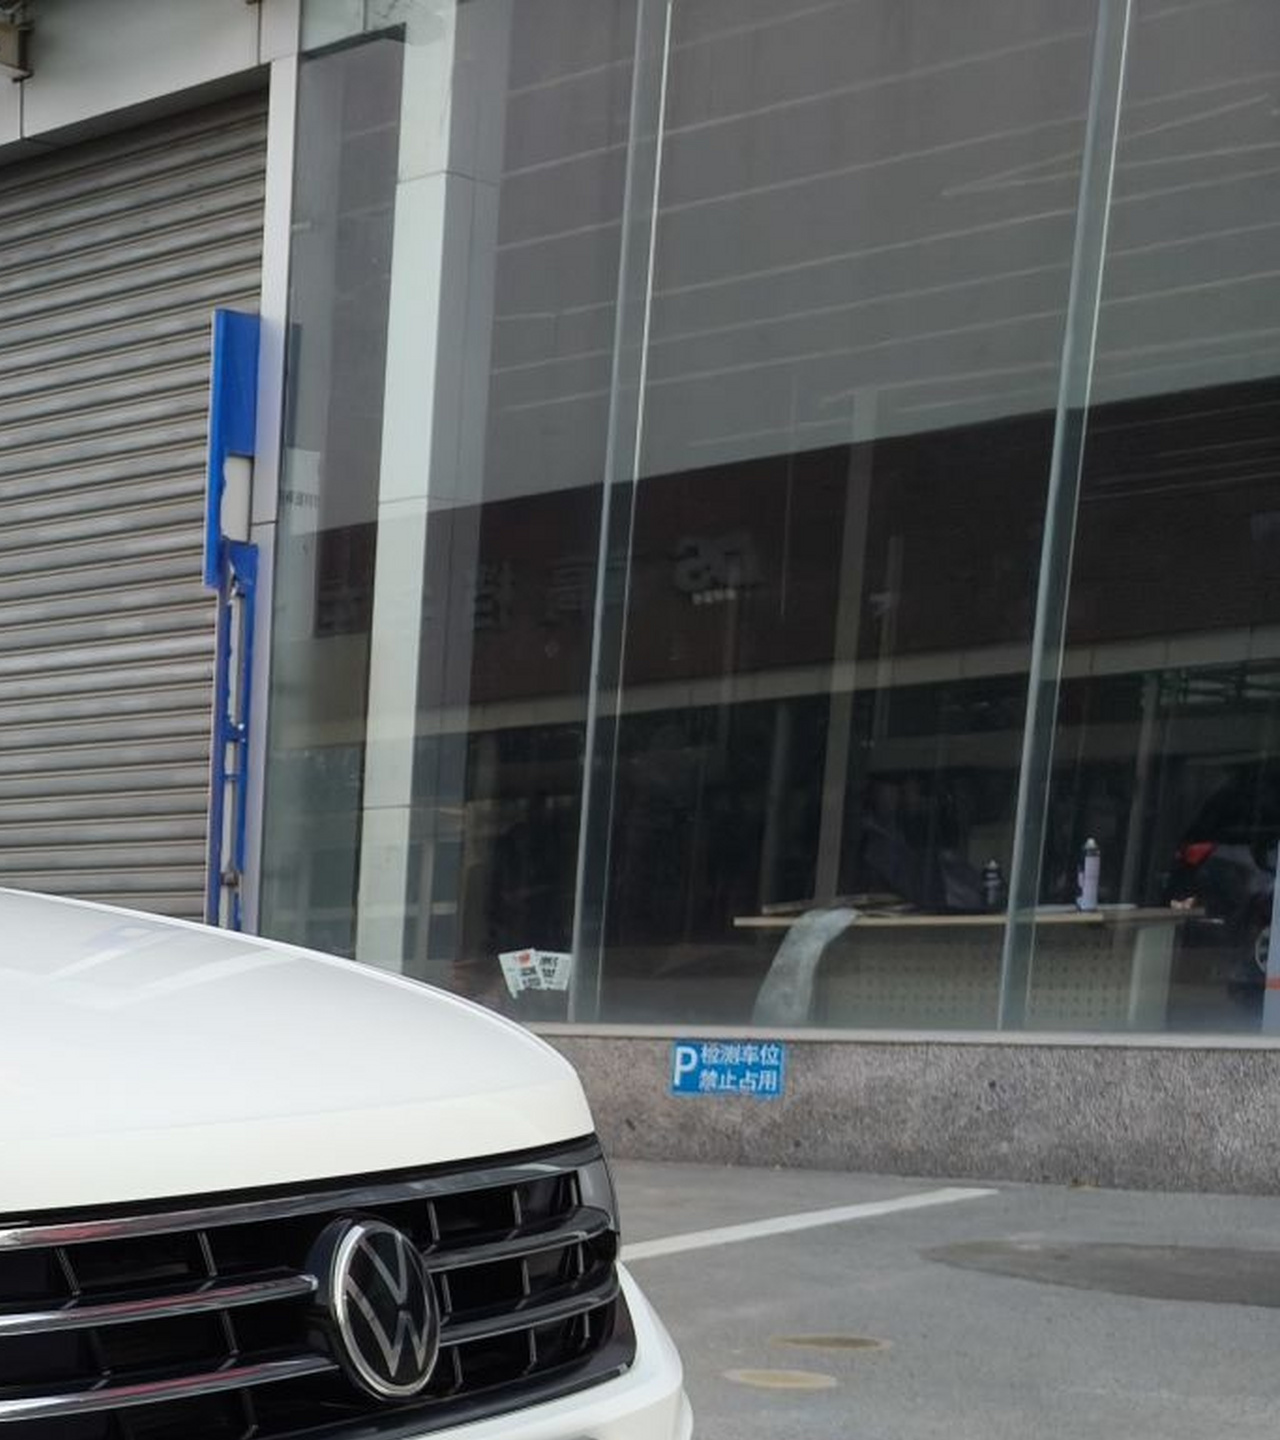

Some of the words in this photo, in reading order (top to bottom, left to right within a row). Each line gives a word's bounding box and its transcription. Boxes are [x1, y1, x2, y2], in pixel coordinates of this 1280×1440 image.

[673, 1046, 698, 1086] P
[701, 1044, 780, 1066] 检测车位
[699, 1070, 777, 1092] 禁止占用
